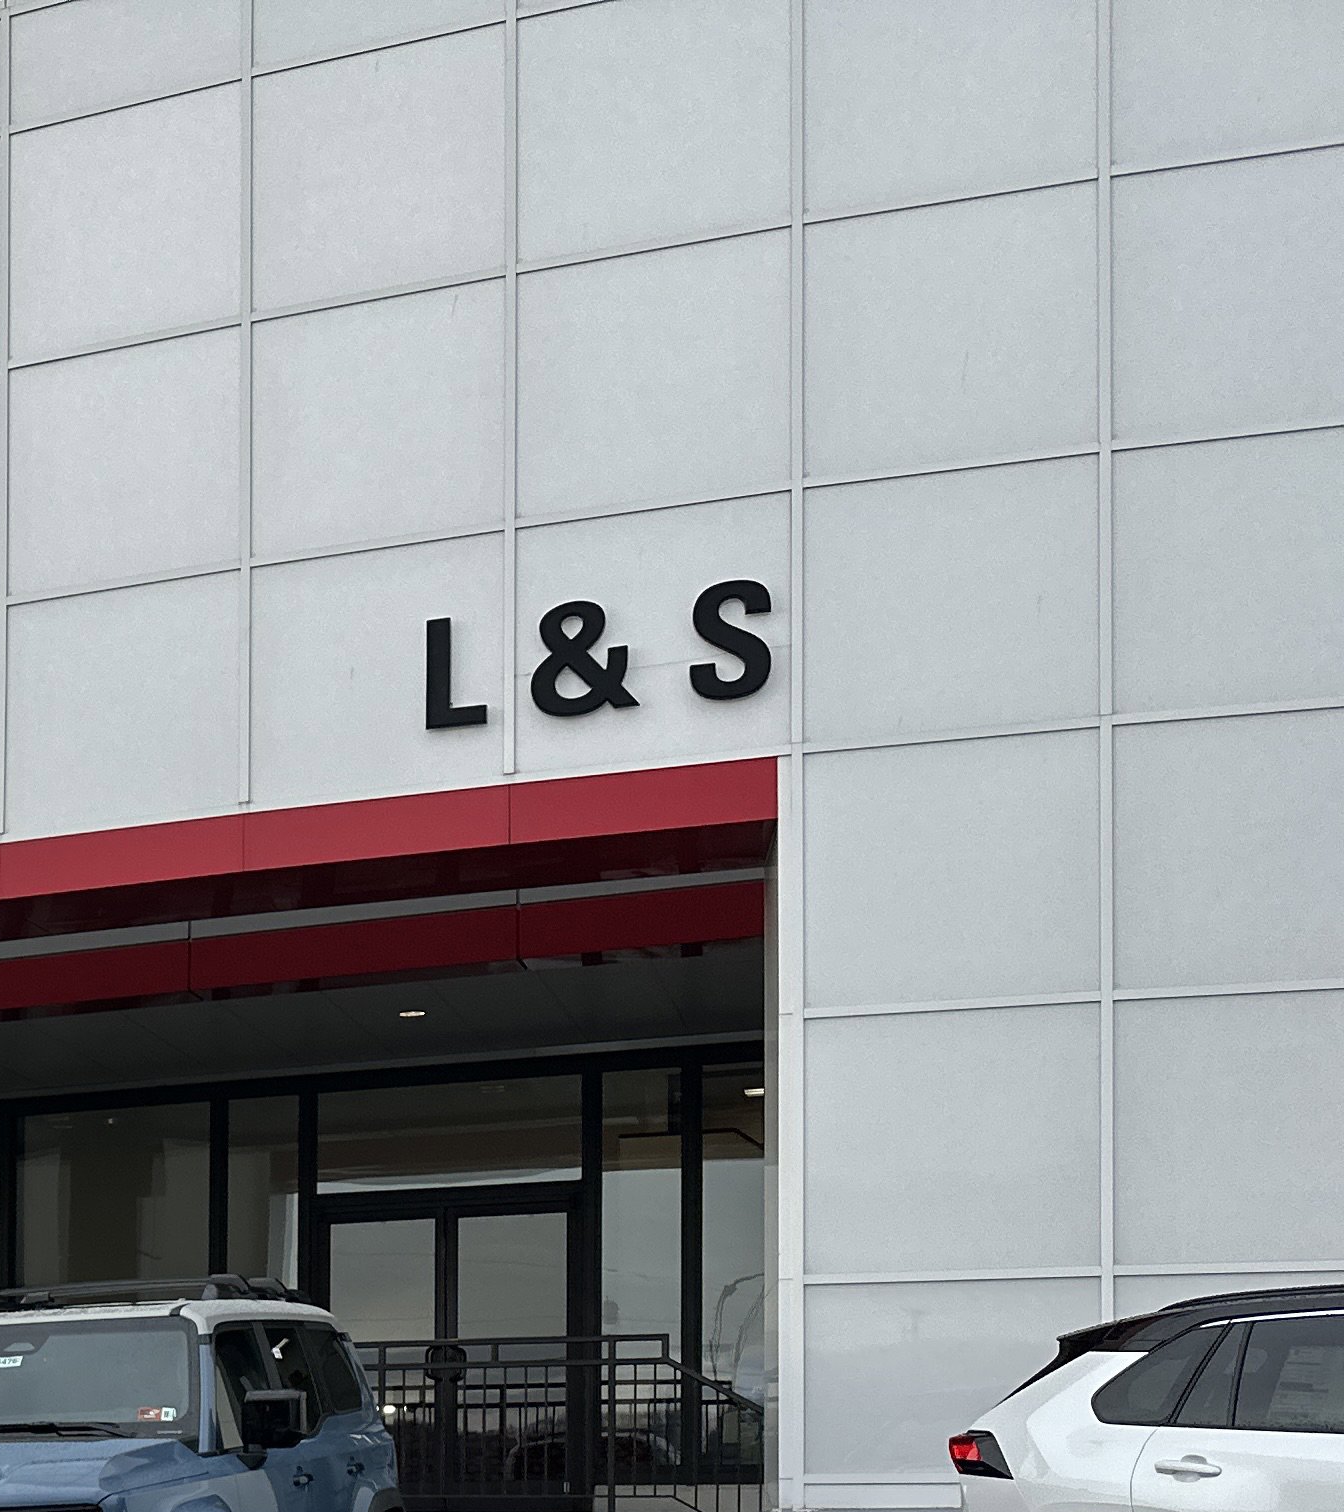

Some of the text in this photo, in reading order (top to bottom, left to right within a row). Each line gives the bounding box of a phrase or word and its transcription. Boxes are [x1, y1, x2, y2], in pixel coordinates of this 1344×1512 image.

[426, 579, 772, 730] L & S
